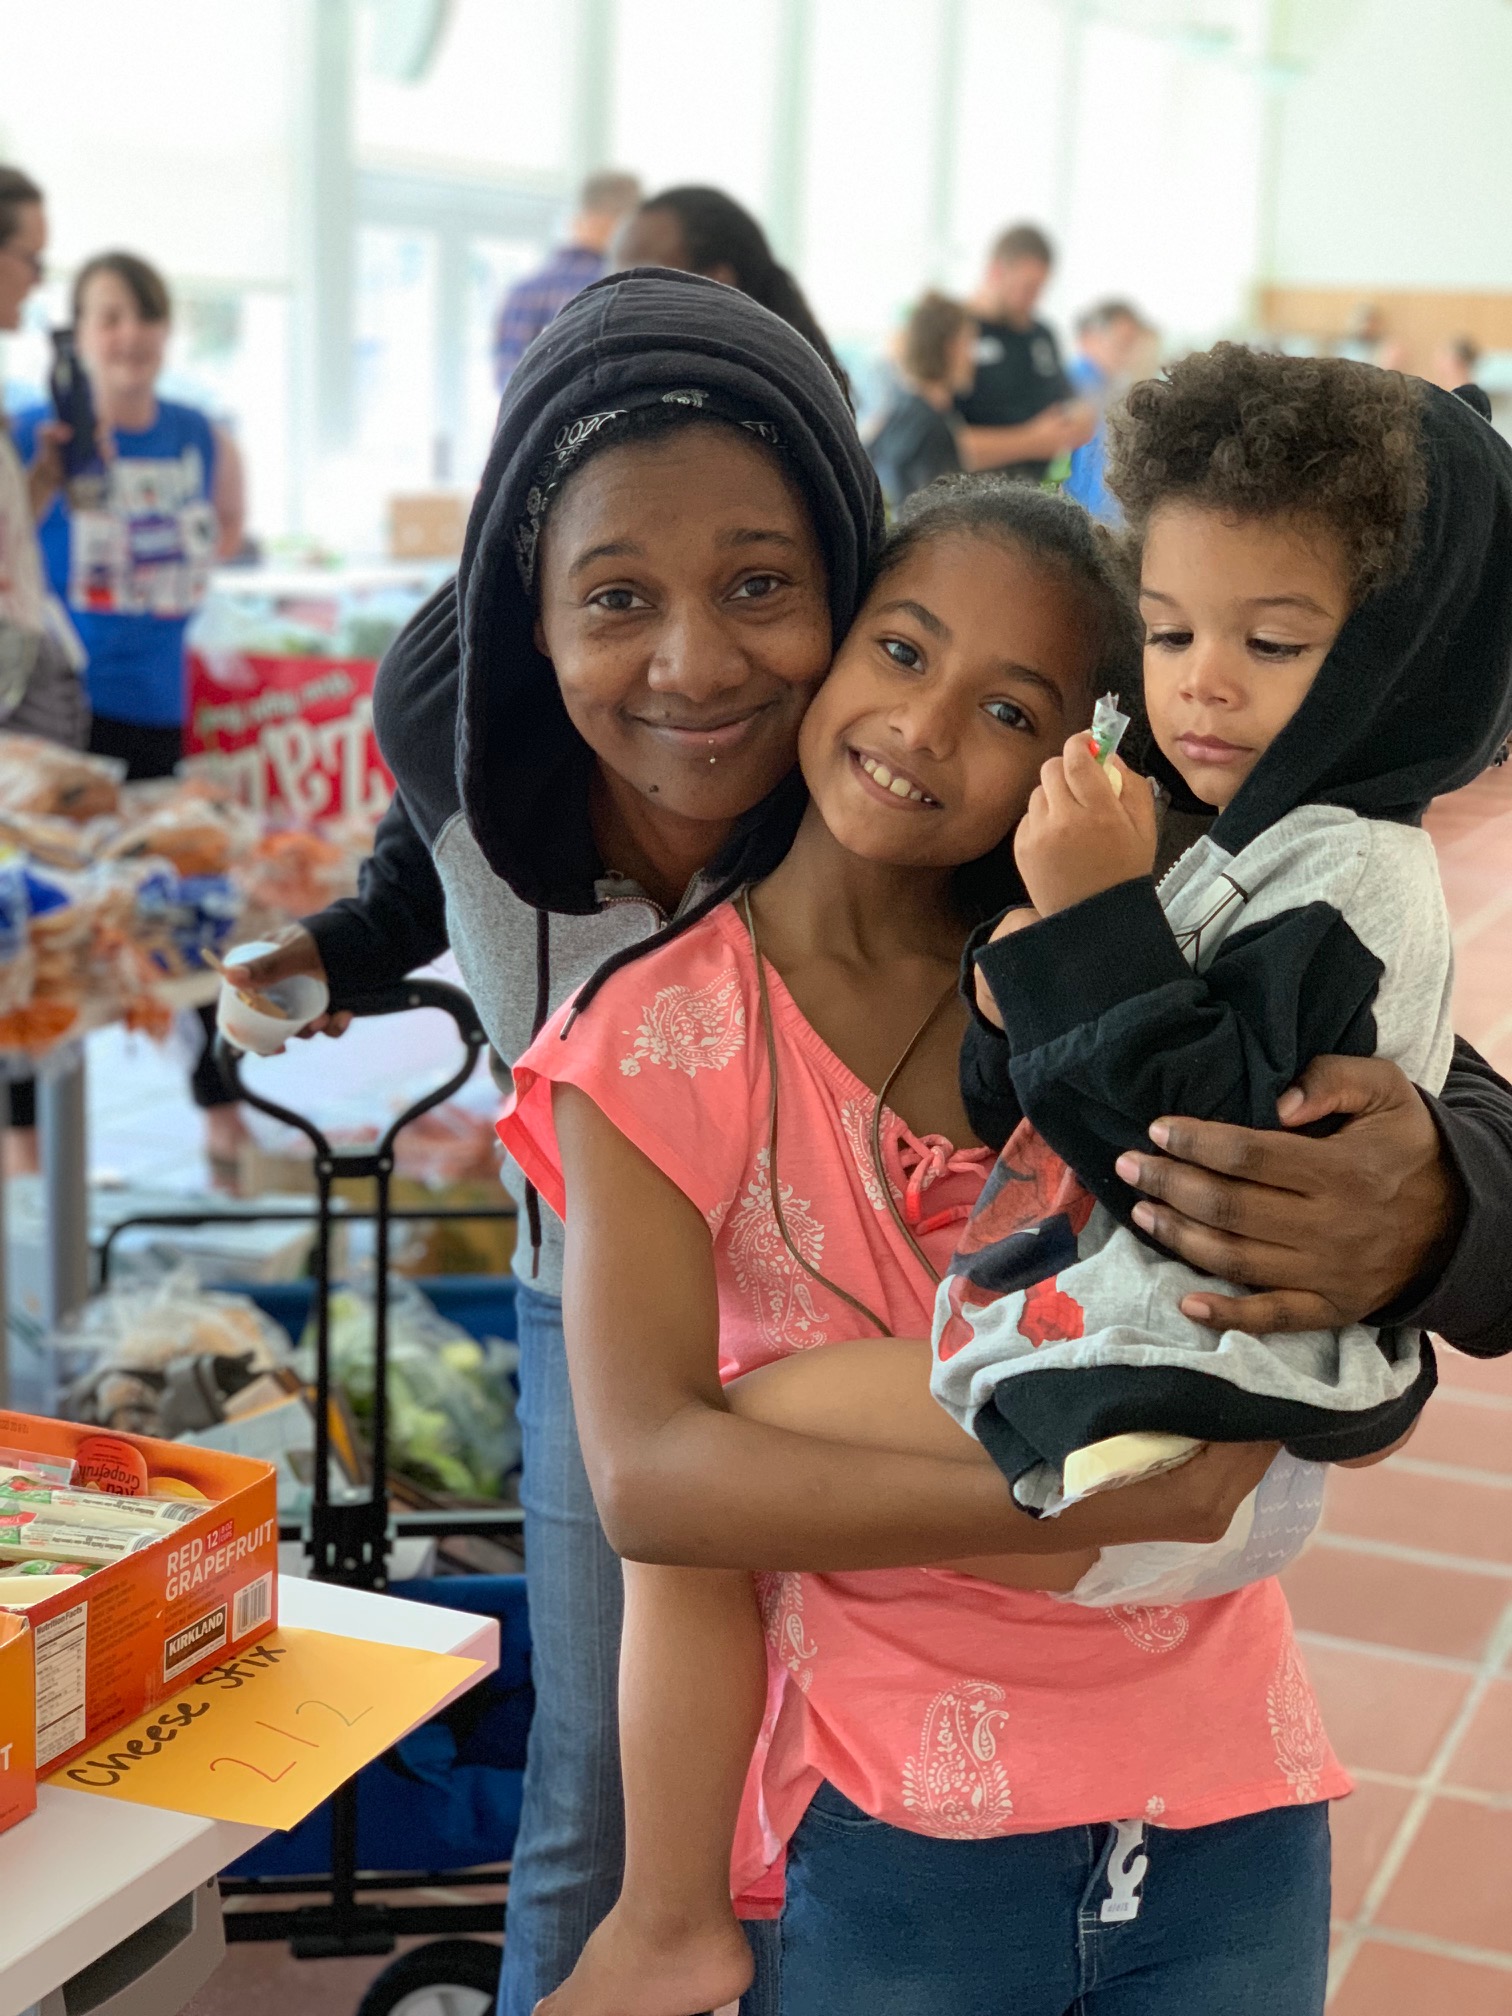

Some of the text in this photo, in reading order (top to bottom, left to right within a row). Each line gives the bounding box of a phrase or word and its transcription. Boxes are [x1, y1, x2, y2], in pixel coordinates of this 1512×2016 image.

[165, 1518, 274, 1602] GRAPEFRUIT
[166, 1537, 203, 1578] RED
[207, 1530, 219, 1550] 12
[168, 1612, 224, 1657] KIRKLAND
[66, 1702, 211, 1787] Cheese
